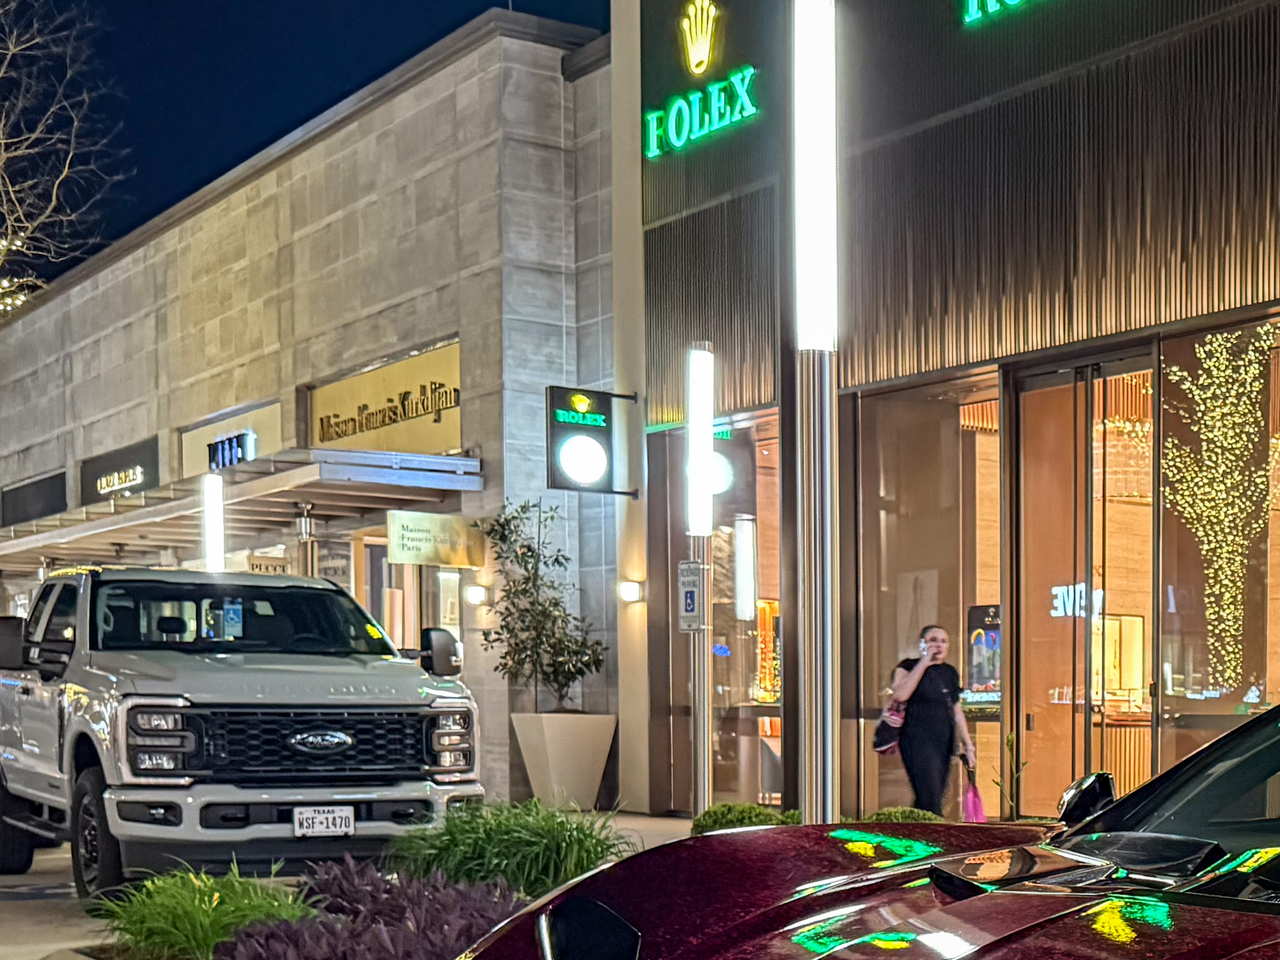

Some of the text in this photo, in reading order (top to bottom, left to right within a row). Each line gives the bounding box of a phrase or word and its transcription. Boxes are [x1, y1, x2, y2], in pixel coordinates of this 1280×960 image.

[644, 65, 758, 160] ROLEX
[556, 409, 607, 427] ROLEX
[401, 524, 431, 534] Maison
[401, 543, 422, 552] Paris
